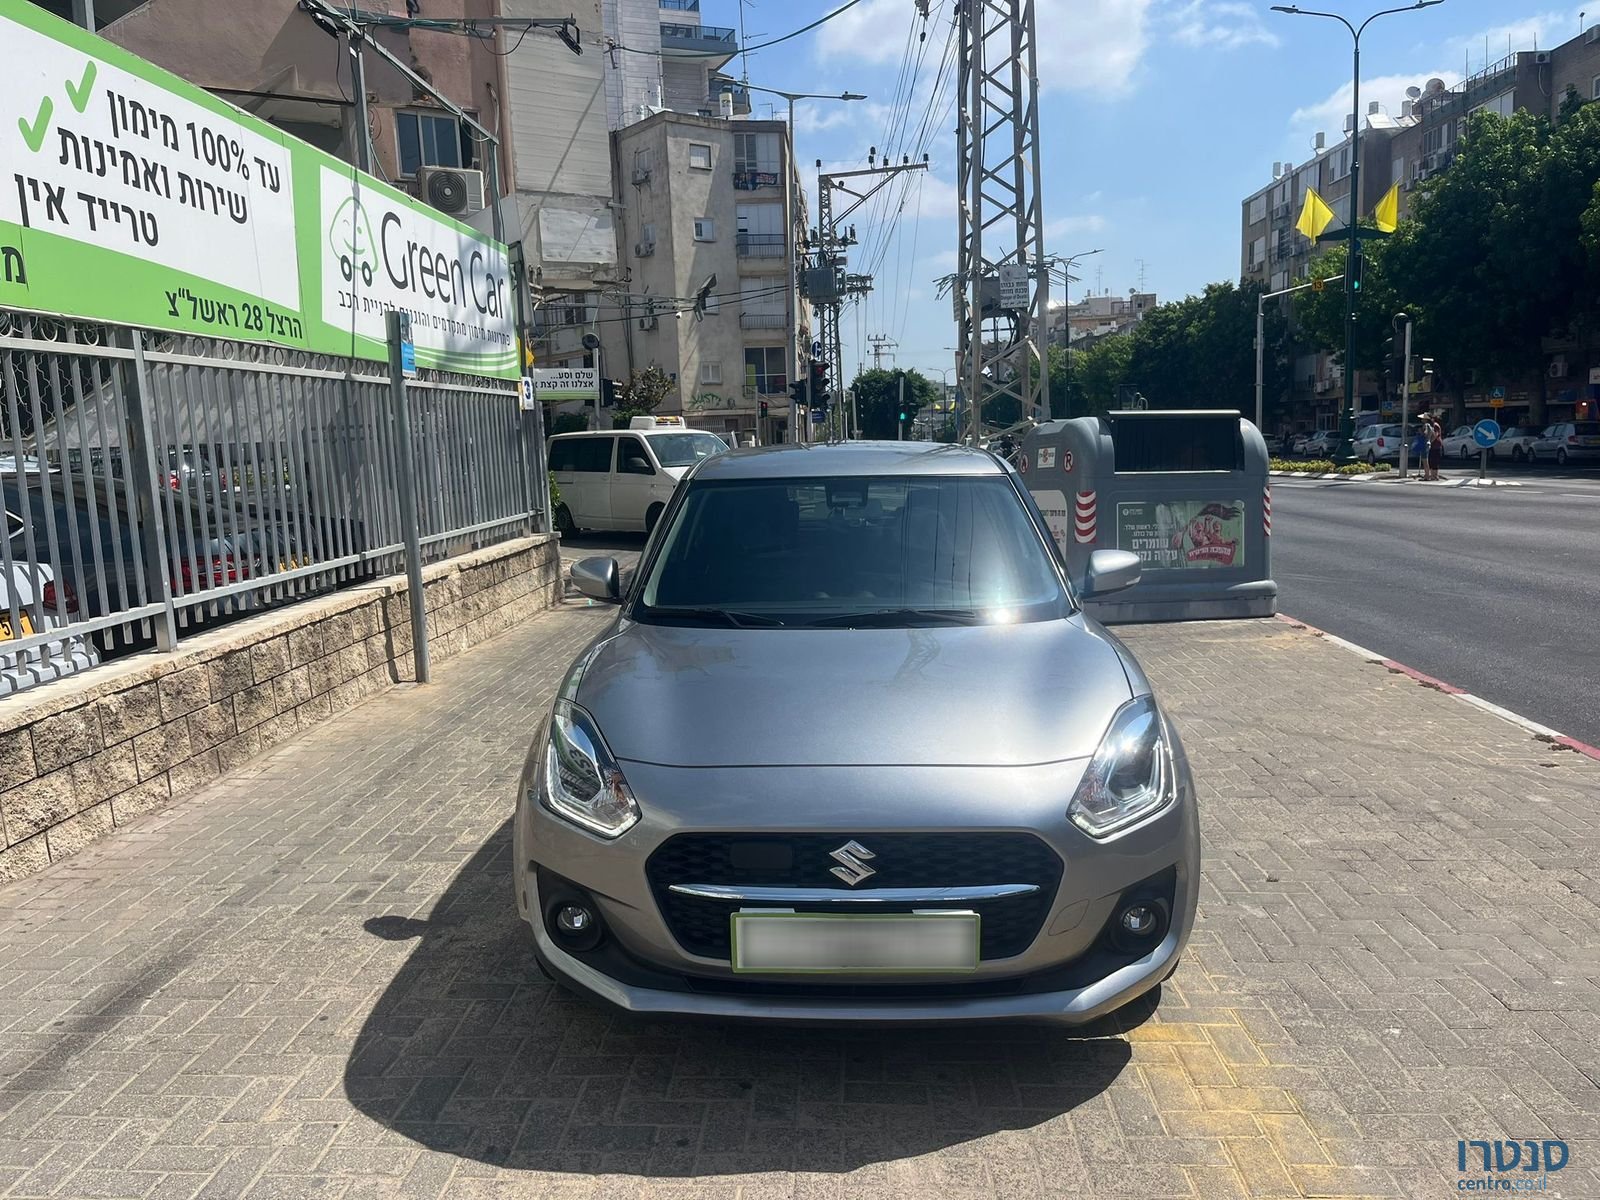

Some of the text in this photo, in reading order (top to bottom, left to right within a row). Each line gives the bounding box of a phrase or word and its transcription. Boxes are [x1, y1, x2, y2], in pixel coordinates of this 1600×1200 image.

[106, 89, 281, 194] עד 100% מימון
[57, 126, 248, 224] שירות ואמינות
[14, 173, 159, 247] טרייד אין
[381, 211, 504, 319] Green Car
[338, 290, 359, 310] רכב
[242, 303, 263, 331] 28
[265, 307, 302, 339] הרצל
[432, 316, 466, 337] מתקדמים
[468, 325, 485, 341] מימון
[540, 380, 558, 389] קצת
[571, 380, 594, 388] אצלנו
[575, 371, 593, 379] שלם
[1131, 538, 1169, 550] שומרים
